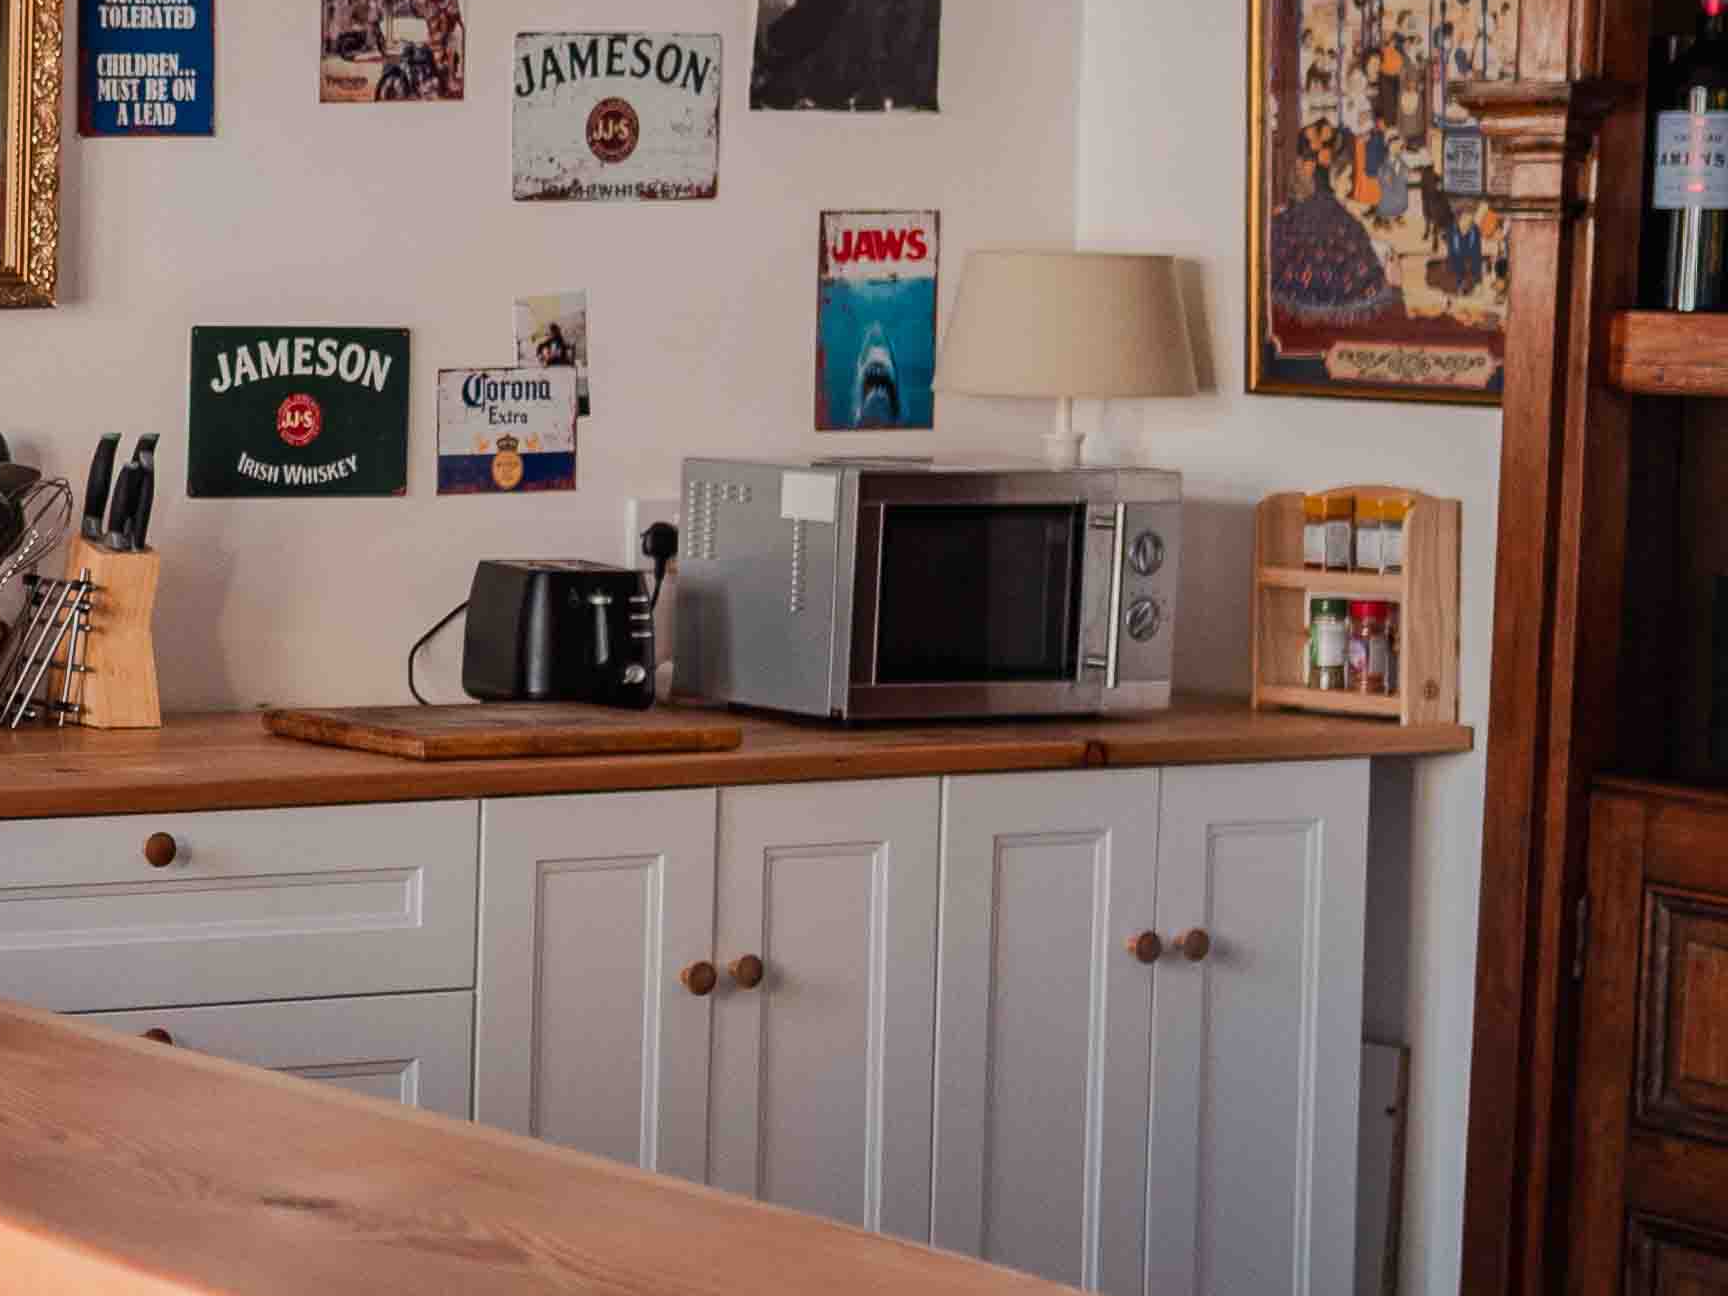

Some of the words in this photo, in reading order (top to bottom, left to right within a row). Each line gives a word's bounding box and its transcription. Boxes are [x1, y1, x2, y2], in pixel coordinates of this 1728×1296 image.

[97, 5, 197, 30] TOLERATED
[514, 35, 712, 98] JAMESON
[96, 78, 141, 102] MUST
[144, 79, 168, 101] BE
[171, 79, 197, 102] ON
[116, 103, 128, 126] A
[133, 103, 177, 126] LEAD
[832, 228, 928, 265] JAWS
[209, 336, 393, 393] JAMESON
[462, 372, 552, 413] Corona
[487, 405, 529, 425] Extra
[237, 451, 279, 484] IRISH
[282, 453, 358, 486] WHISKEY
